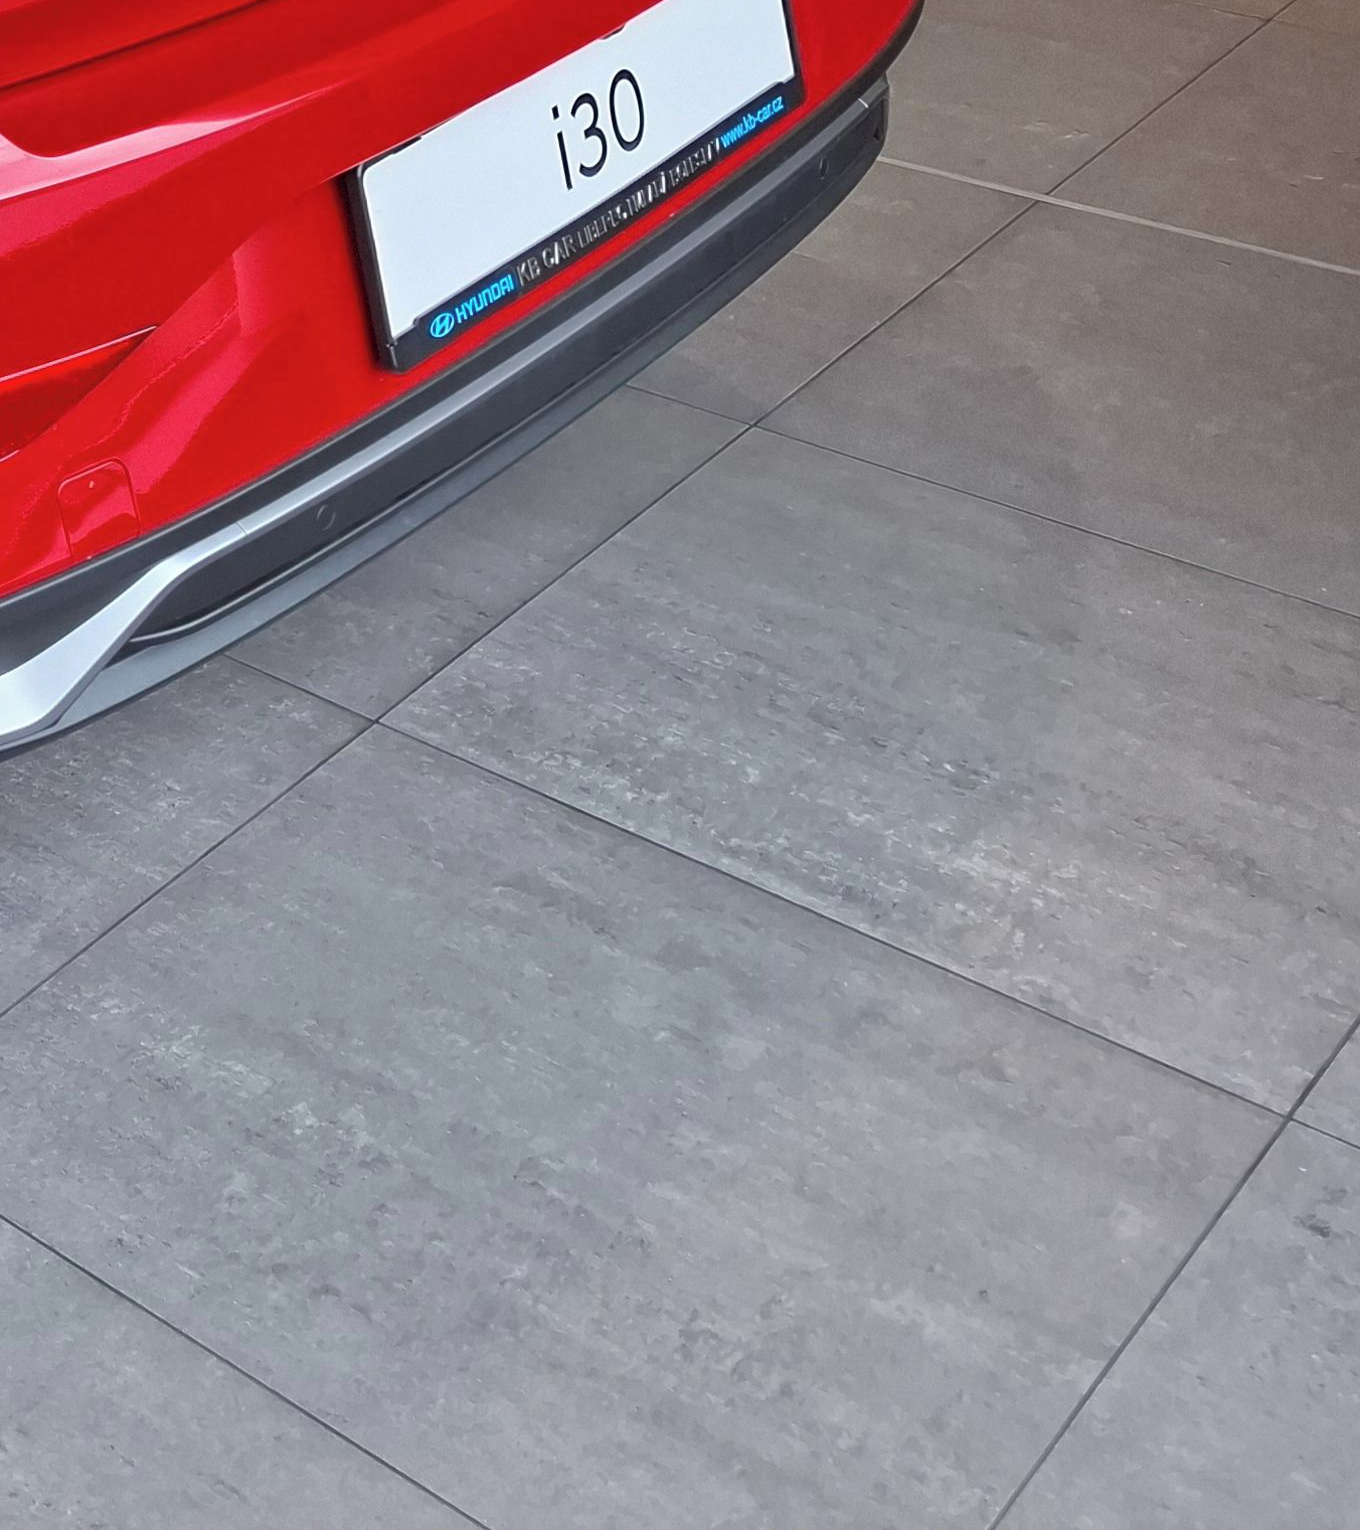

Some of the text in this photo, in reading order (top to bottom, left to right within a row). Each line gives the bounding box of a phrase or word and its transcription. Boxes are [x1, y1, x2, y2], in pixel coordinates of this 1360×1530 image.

[454, 274, 514, 324] HYUNDAI
[516, 257, 541, 287] KB
[542, 235, 577, 269] CAR
[720, 96, 785, 149] www.kb-car.cz
[551, 68, 645, 191] i30
